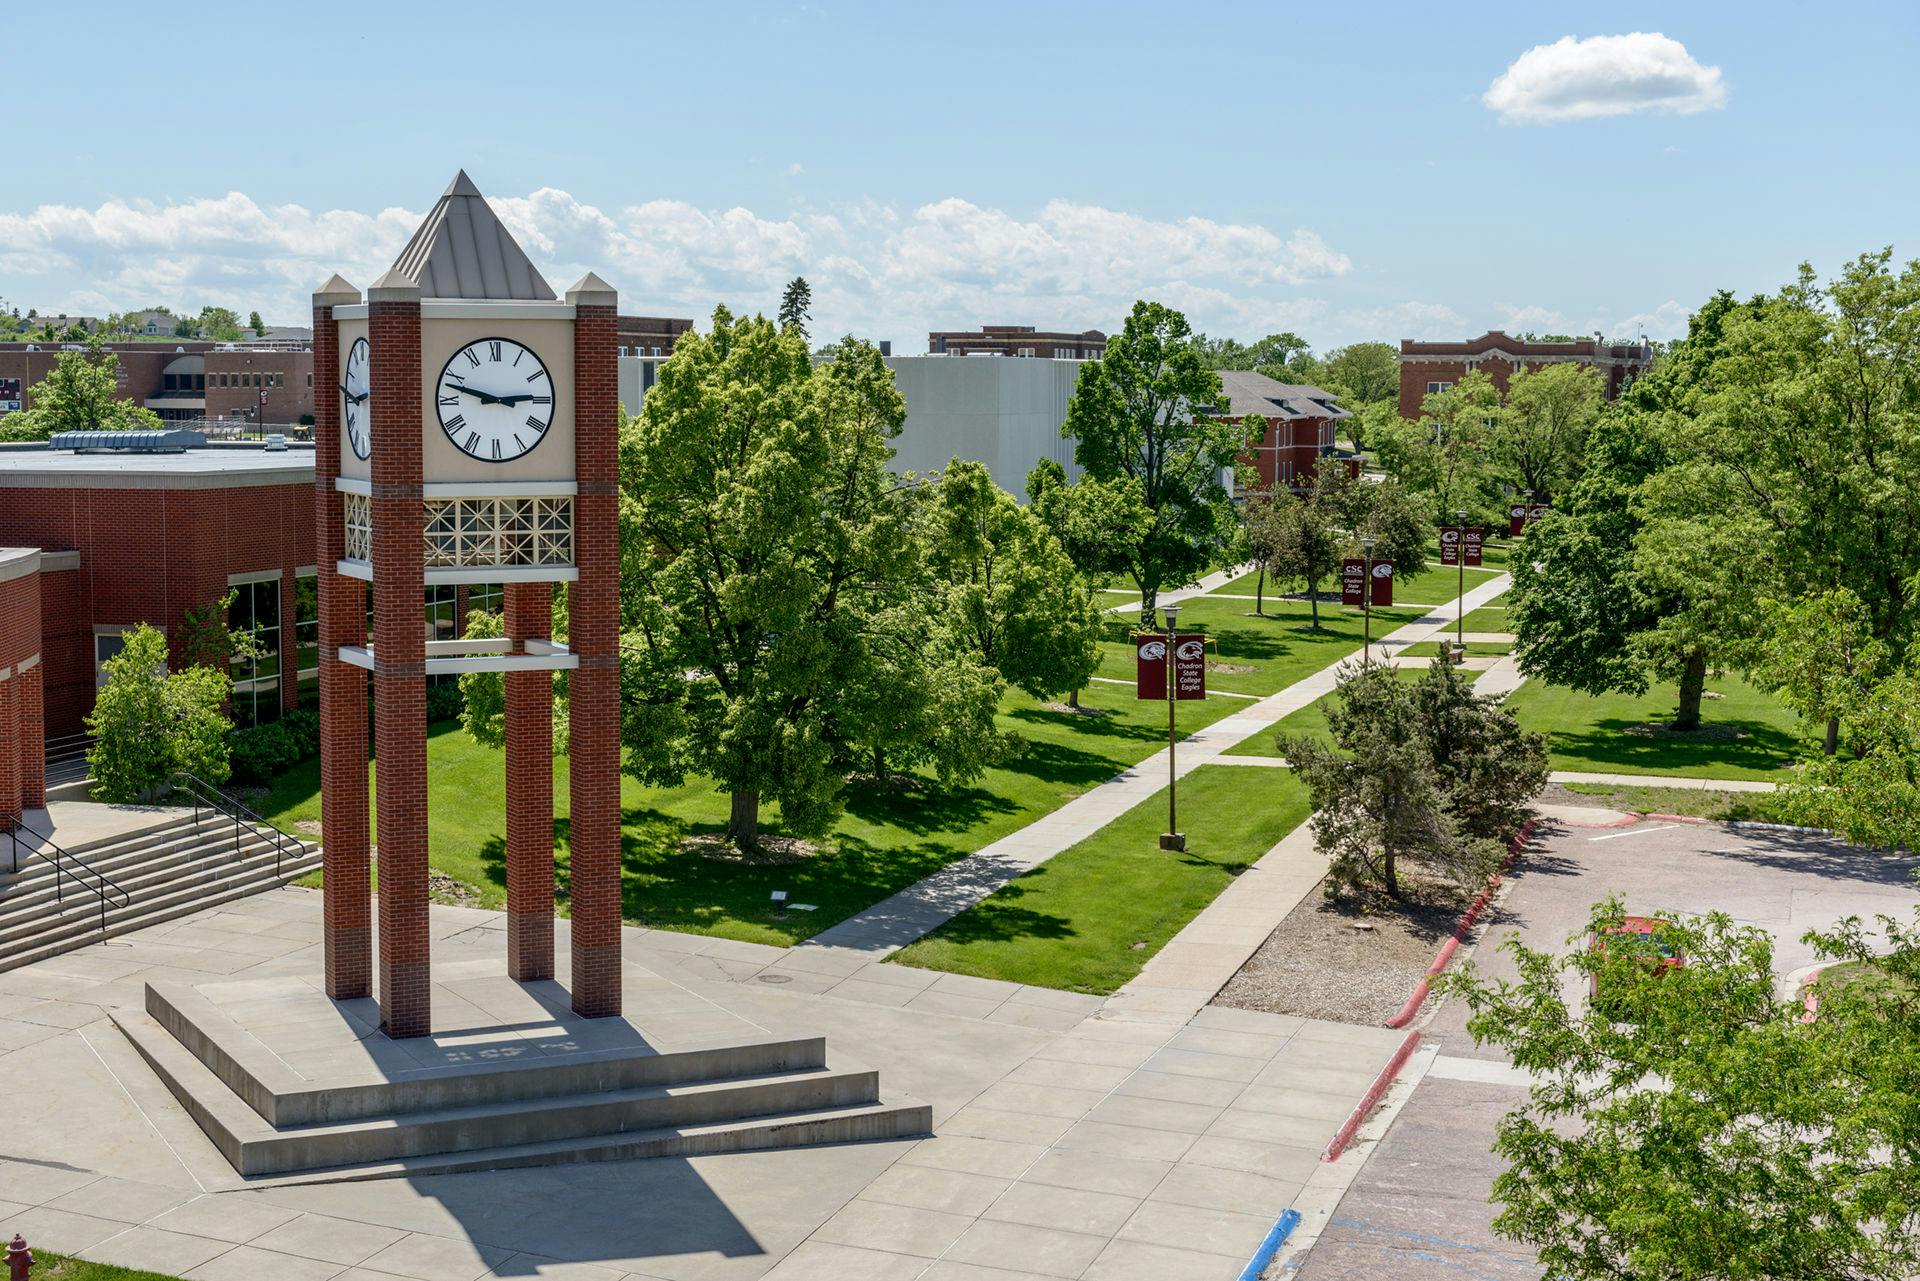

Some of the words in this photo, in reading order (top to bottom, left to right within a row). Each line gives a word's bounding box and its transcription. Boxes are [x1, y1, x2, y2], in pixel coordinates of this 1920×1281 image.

[463, 347, 481, 369] XI
[489, 341, 501, 362] XII
[513, 349, 524, 367] I
[445, 368, 465, 384] X
[526, 369, 544, 383] II
[439, 395, 459, 406] IX
[532, 396, 551, 404] III
[444, 414, 467, 436] VIII
[463, 431, 481, 454] VII
[492, 438, 502, 459] VI
[513, 433, 527, 452] V
